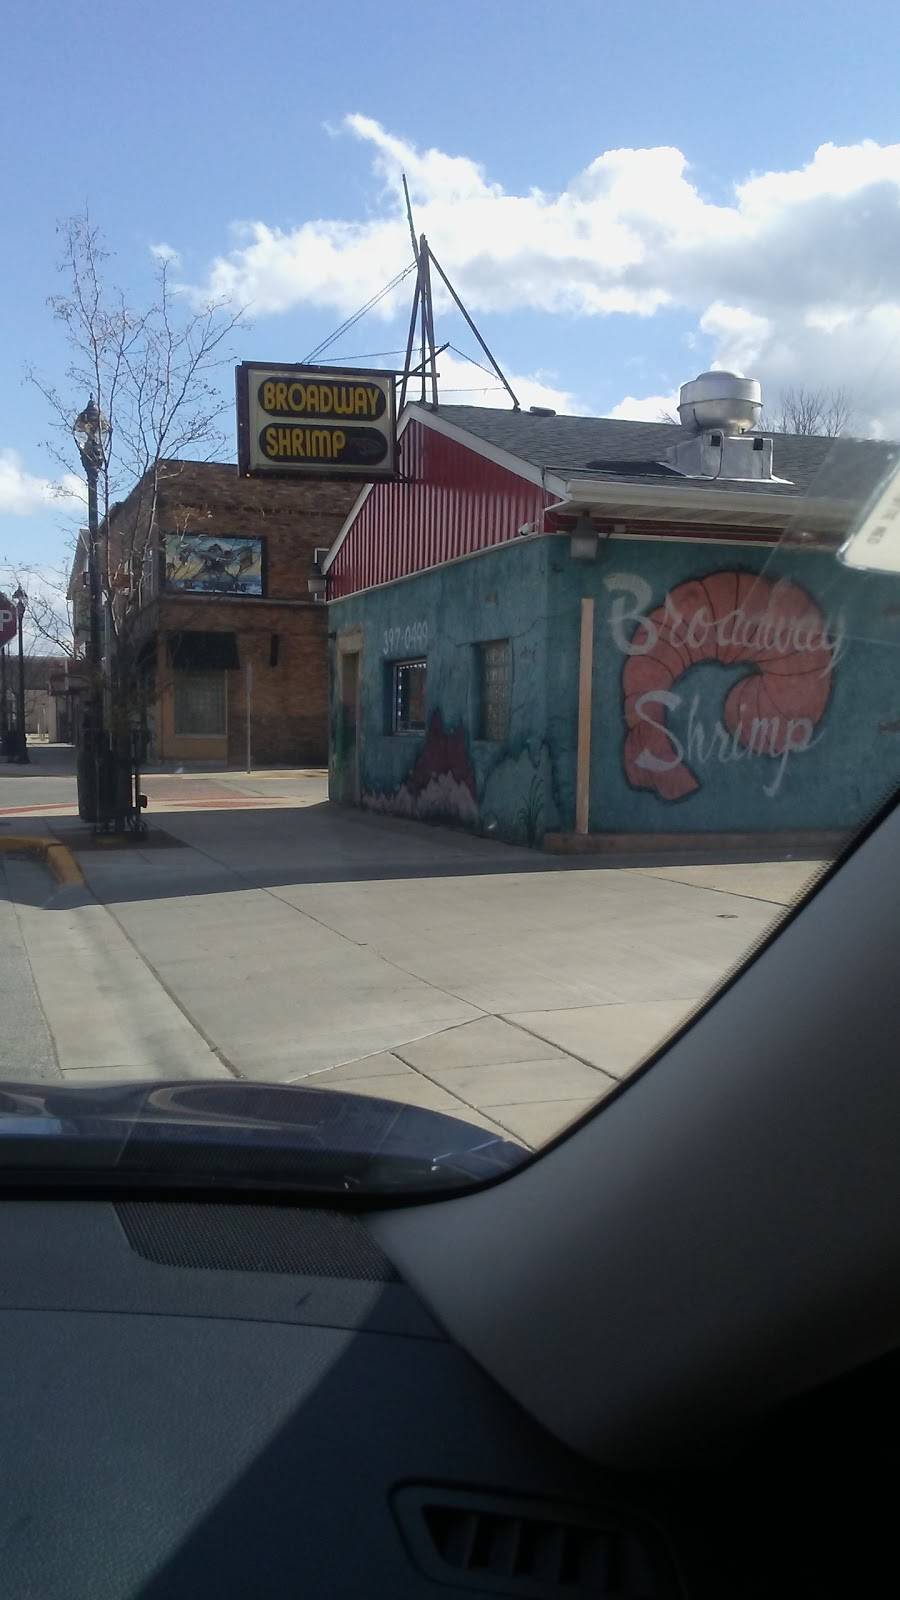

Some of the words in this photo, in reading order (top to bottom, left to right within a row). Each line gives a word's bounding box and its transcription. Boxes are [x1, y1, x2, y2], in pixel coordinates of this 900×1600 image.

[263, 382, 380, 416] BROADWAY
[265, 427, 347, 458] SHRIMP
[603, 572, 847, 680] Broadway
[634, 689, 827, 797] Shrimp
